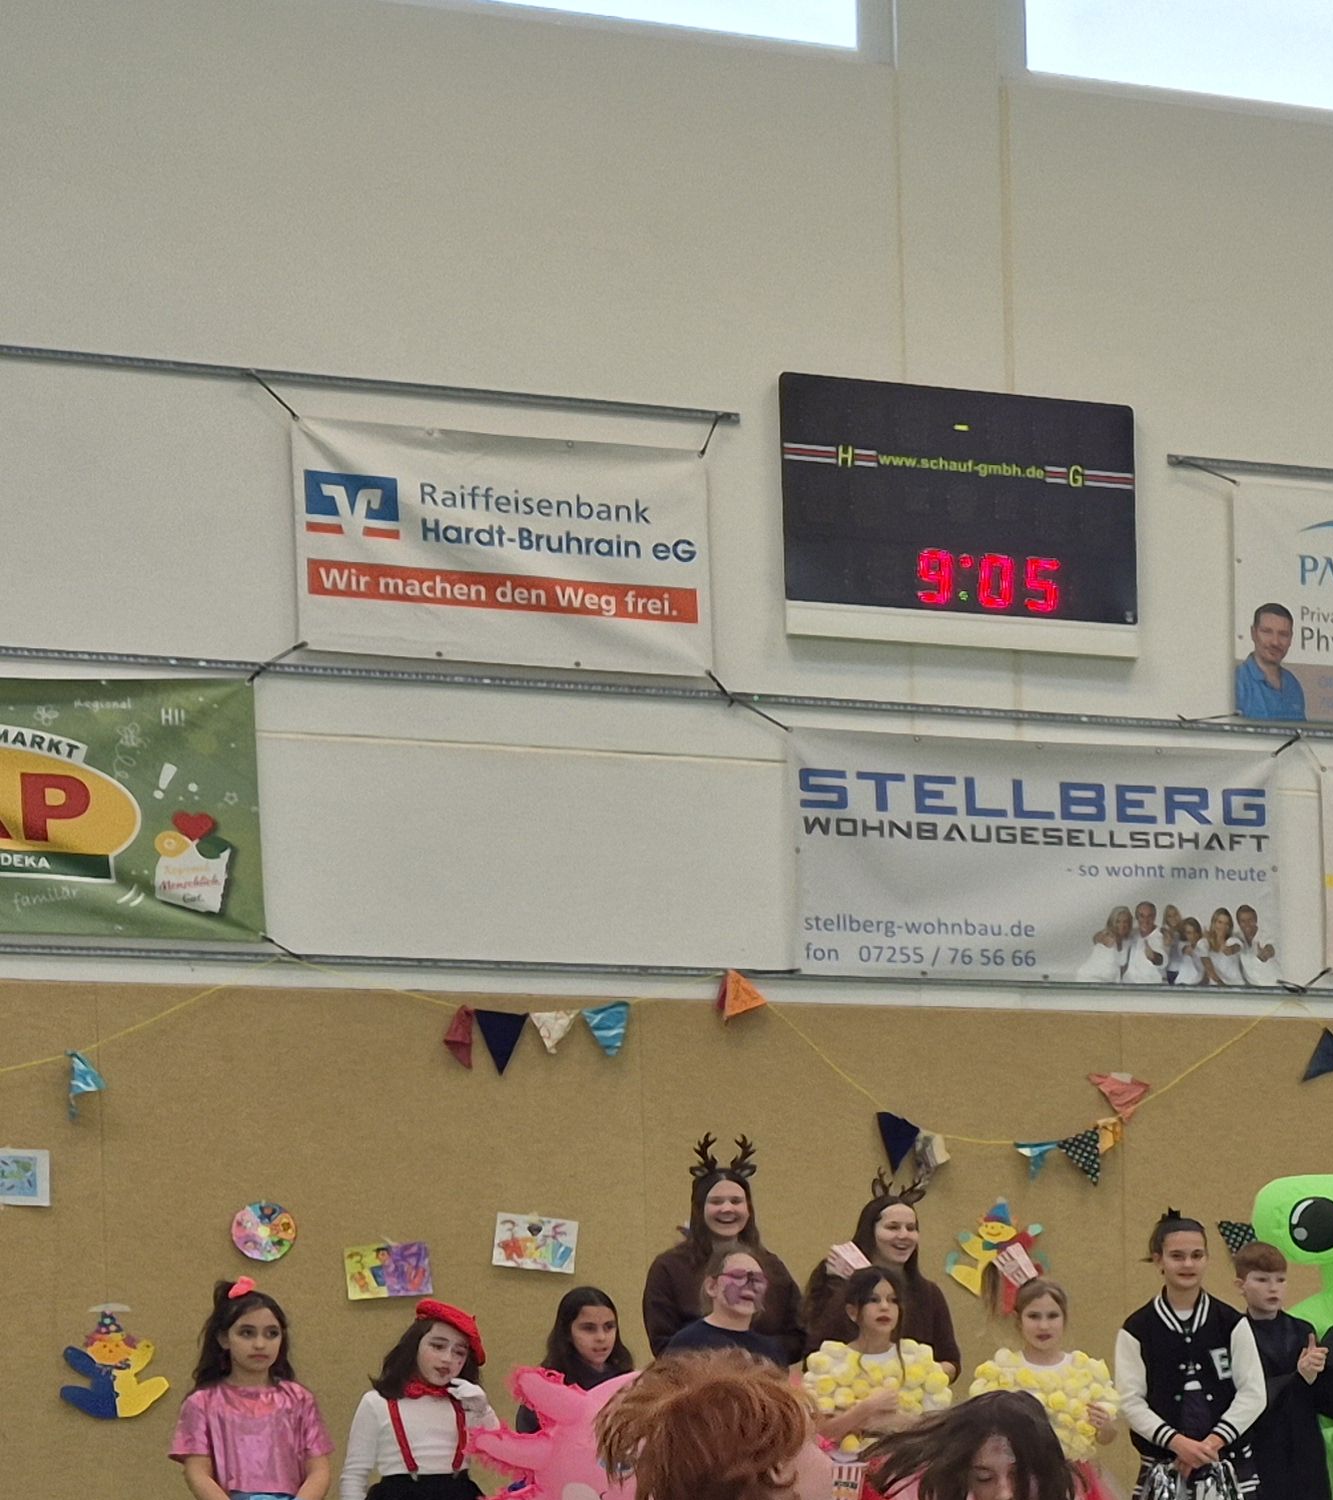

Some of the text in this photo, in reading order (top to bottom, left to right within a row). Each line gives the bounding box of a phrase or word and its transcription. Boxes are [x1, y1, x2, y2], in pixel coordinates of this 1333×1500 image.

[837, 444, 853, 468] H
[878, 452, 1045, 481] www.schauf-gmbh.de
[1067, 464, 1085, 488] G
[419, 482, 651, 525] Raiffeisenbank
[421, 518, 698, 563] Hardt-Bruhrain eG
[318, 565, 679, 617] Wir machen den Weg frei.
[915, 547, 1062, 613] 9:05
[74, 697, 132, 712] Regional
[160, 707, 186, 727] HI!
[799, 767, 1267, 828] STELLBERG
[802, 814, 1270, 853] WOHNBAUGESELLSCHAFT
[1078, 863, 1100, 879] so
[1104, 862, 1166, 880] wohnt
[1170, 866, 1210, 882] man
[1213, 864, 1269, 884] heute
[803, 912, 1036, 940] stellberg-wohnbau.de
[804, 941, 1038, 969] fon 07255 / 76 56 66
[1209, 1347, 1232, 1380] E
